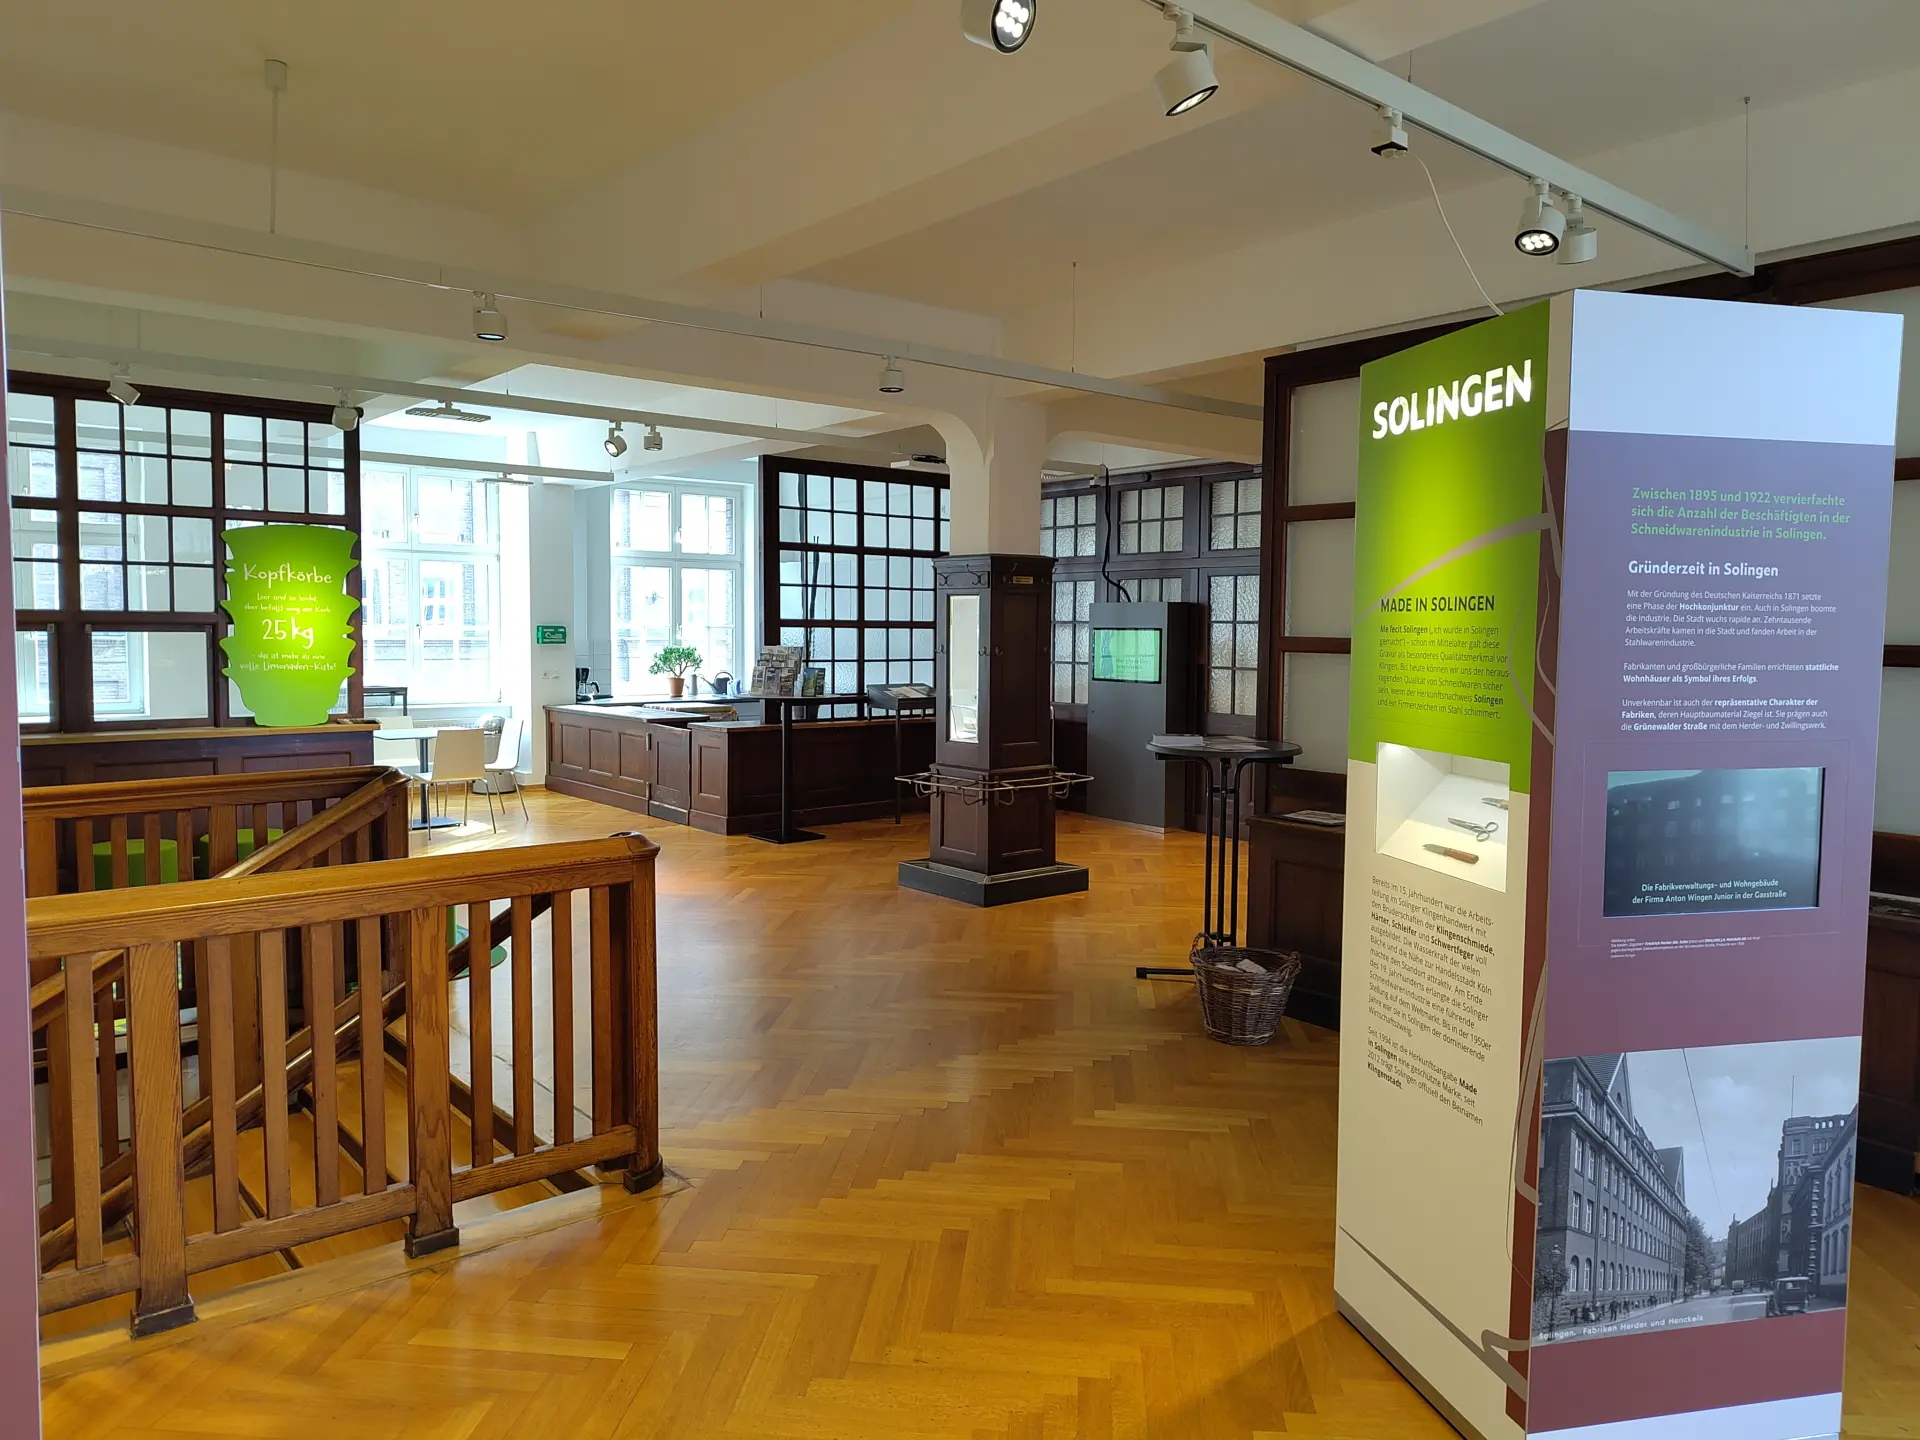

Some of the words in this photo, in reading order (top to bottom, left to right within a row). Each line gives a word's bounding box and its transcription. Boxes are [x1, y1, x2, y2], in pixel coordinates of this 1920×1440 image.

[1373, 359, 1532, 439] SOLINGEN
[1632, 487, 1686, 500] Zwischen
[1689, 489, 1717, 501] 1895
[1720, 491, 1741, 502] und
[1744, 491, 1771, 503] 1922
[1774, 493, 1845, 505] vervierfachte
[1631, 505, 1654, 517] sich
[1657, 506, 1674, 517] die
[1678, 507, 1717, 519] Anzahl
[1720, 508, 1738, 519] der
[1741, 509, 1816, 525] Beschäftigten
[1820, 511, 1829, 522] in
[1832, 512, 1850, 523] der
[1630, 523, 1760, 537] Schneidwarenindustrie
[1763, 527, 1772, 538] in
[1775, 527, 1826, 542] Solingen.
[244, 562, 332, 588] Kopfkörbe
[1628, 560, 1705, 575] Gründerzeit
[1708, 562, 1720, 575] in
[1724, 562, 1779, 579] Solingen
[1381, 598, 1412, 612] MADE
[1416, 598, 1427, 611] IN
[1431, 595, 1494, 611] SOLINGEN
[1654, 590, 1689, 600] Gründung
[1679, 602, 1739, 612] Hochkonjunktur
[1780, 604, 1809, 614] Solingen
[1729, 616, 1750, 625] rapide
[262, 619, 287, 640] 25
[292, 616, 314, 649] kg
[1403, 626, 1428, 635] Solingen
[1471, 627, 1498, 637] Solingen
[1625, 638, 1696, 646] Stahlwarenindustrie.
[1682, 663, 1737, 672] großbürgerliche
[1684, 675, 1711, 684] Symbol
[1732, 675, 1758, 685] Erfolgs.
[1714, 699, 1768, 708] repräsentative
[1680, 711, 1742, 720] Hauptbaumaterial
[1743, 711, 1763, 719] Ziegel
[1786, 710, 1810, 719] prägen
[1781, 722, 1826, 731] Zwillingswerk.
[1655, 882, 1718, 891] Fabrikverwaltungs-
[1734, 879, 1778, 888] Wohngebäude
[1372, 876, 1390, 889] Bereits
[1391, 882, 1398, 892] im
[1409, 888, 1443, 908] Jahrhundert
[1444, 903, 1456, 913] war
[1457, 906, 1467, 917] die
[1468, 910, 1494, 926] Arbeits-
[1688, 893, 1712, 902] Wingen
[1714, 892, 1733, 901] Junior
[1755, 890, 1786, 898] Gasstraße
[1372, 889, 1389, 904] teilung
[1391, 895, 1397, 904] im
[1398, 898, 1420, 913] Solinger
[1422, 906, 1474, 933] Klingenhandwerk
[1476, 928, 1486, 938] mit
[1372, 900, 1381, 910] den
[1425, 920, 1435, 932] der
[1437, 924, 1495, 957] Klingenschmiede,
[1371, 911, 1390, 928] Härter,
[1392, 920, 1416, 937] Schleifer
[1418, 932, 1430, 942] und
[1431, 935, 1474, 960] Schwertfeger
[1476, 955, 1488, 966] voll
[1583, 1325, 1617, 1335] Fabriken
[1620, 1321, 1647, 1330] Herder
[1668, 1315, 1703, 1325] Henckels
